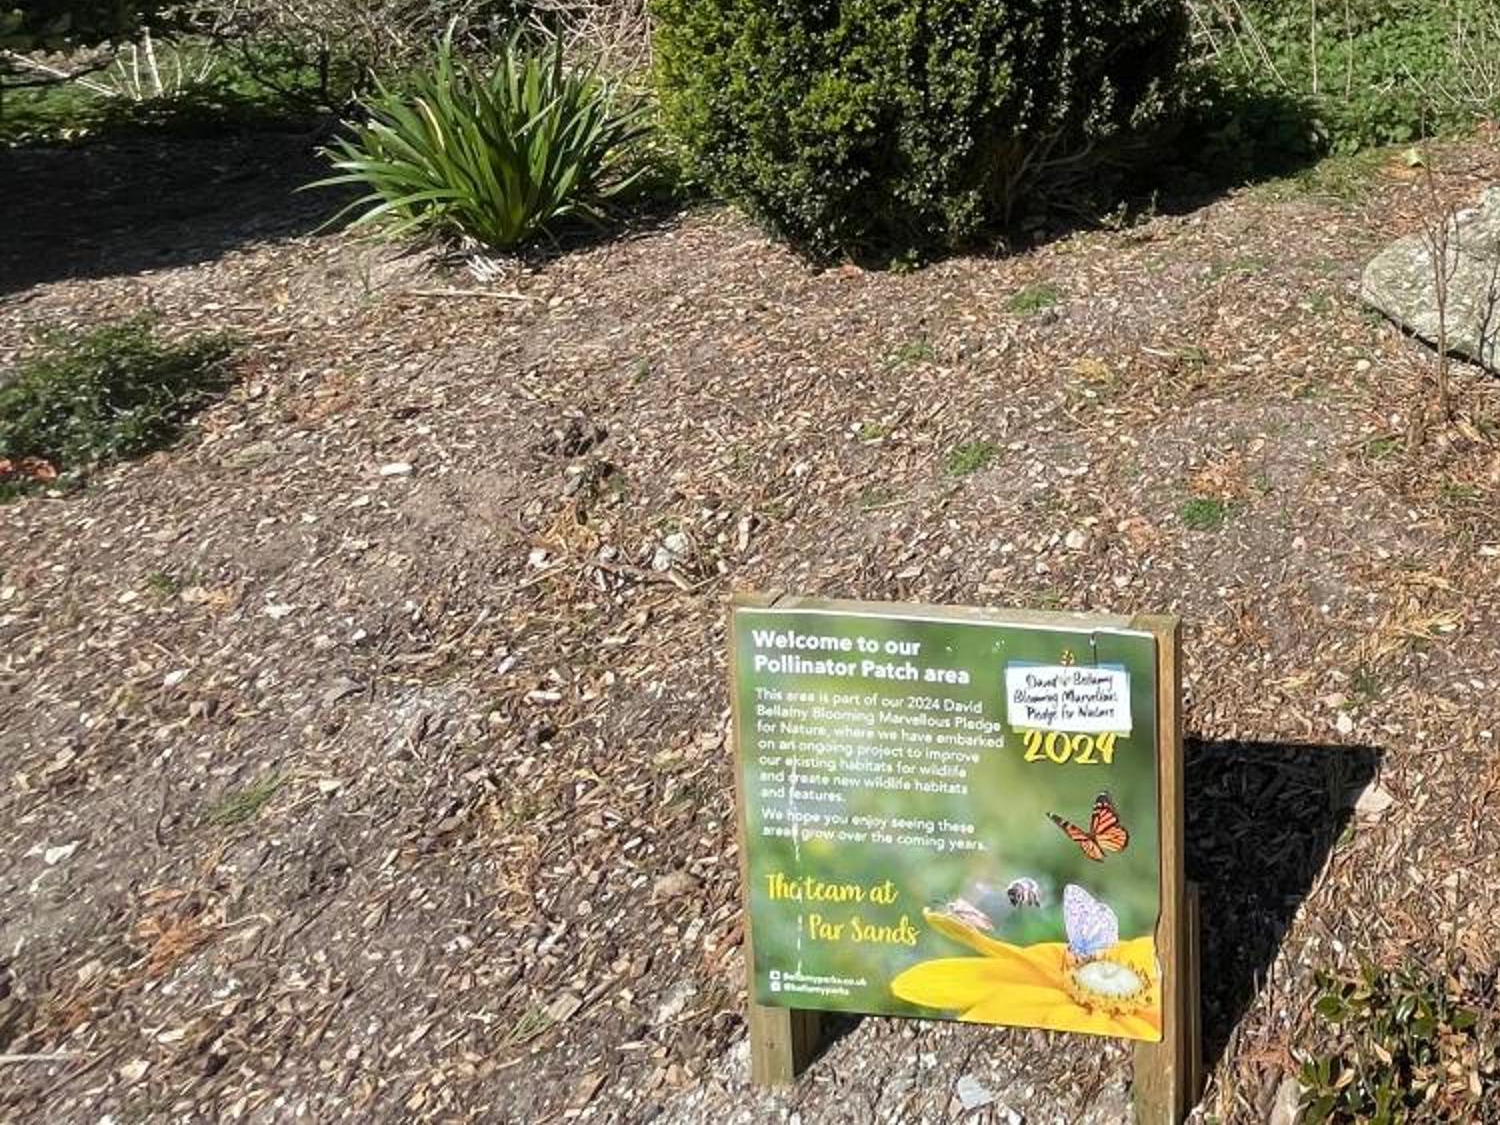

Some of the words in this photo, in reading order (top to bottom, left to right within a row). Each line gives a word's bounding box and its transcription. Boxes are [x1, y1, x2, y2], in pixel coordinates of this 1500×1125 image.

[752, 630, 853, 652] Welcome
[857, 636, 879, 654] to
[884, 640, 921, 656] our
[754, 654, 857, 678] Pollinator
[861, 660, 919, 681] Patch
[924, 667, 970, 684] area
[756, 688, 783, 701] This
[785, 692, 816, 703] area
[818, 690, 830, 704] is
[832, 693, 862, 709] part
[863, 692, 880, 706] of
[881, 698, 905, 709] our
[907, 696, 940, 711] 2024
[943, 698, 984, 713] David
[757, 704, 809, 722] Bellamy
[813, 707, 876, 727] Blooming
[880, 711, 951, 727] Marvellous
[955, 716, 1001, 733] Pledge
[757, 720, 778, 732] for
[833, 725, 875, 738] where
[878, 729, 898, 740] we
[901, 728, 933, 743] have
[936, 733, 1005, 748] embarked
[1023, 730, 1116, 764] 2024
[758, 740, 775, 750] on
[779, 741, 798, 751] an
[798, 742, 853, 758] ongoing
[857, 743, 903, 762] project
[906, 747, 923, 758] to
[925, 747, 980, 764] improve
[759, 756, 781, 767] our
[784, 756, 837, 773] existing
[839, 759, 893, 773] habitats
[896, 760, 917, 774] for
[919, 763, 967, 778] wildlife
[759, 770, 785, 782] and
[833, 776, 861, 787] new
[863, 776, 911, 790] wildlife
[914, 779, 968, 794] habitats
[760, 786, 785, 798] and
[760, 806, 783, 820] We
[785, 809, 821, 826] hope
[823, 815, 849, 828] you
[851, 815, 888, 831] enjoy
[891, 817, 935, 835] seeing
[937, 819, 975, 835] these
[801, 828, 835, 842] grow
[838, 830, 867, 841] over
[871, 831, 893, 844] the
[896, 835, 945, 851] coming
[766, 872, 802, 901] The
[804, 876, 866, 902] team
[869, 879, 899, 904] at
[809, 912, 845, 941] Par
[850, 914, 921, 946] Sands
